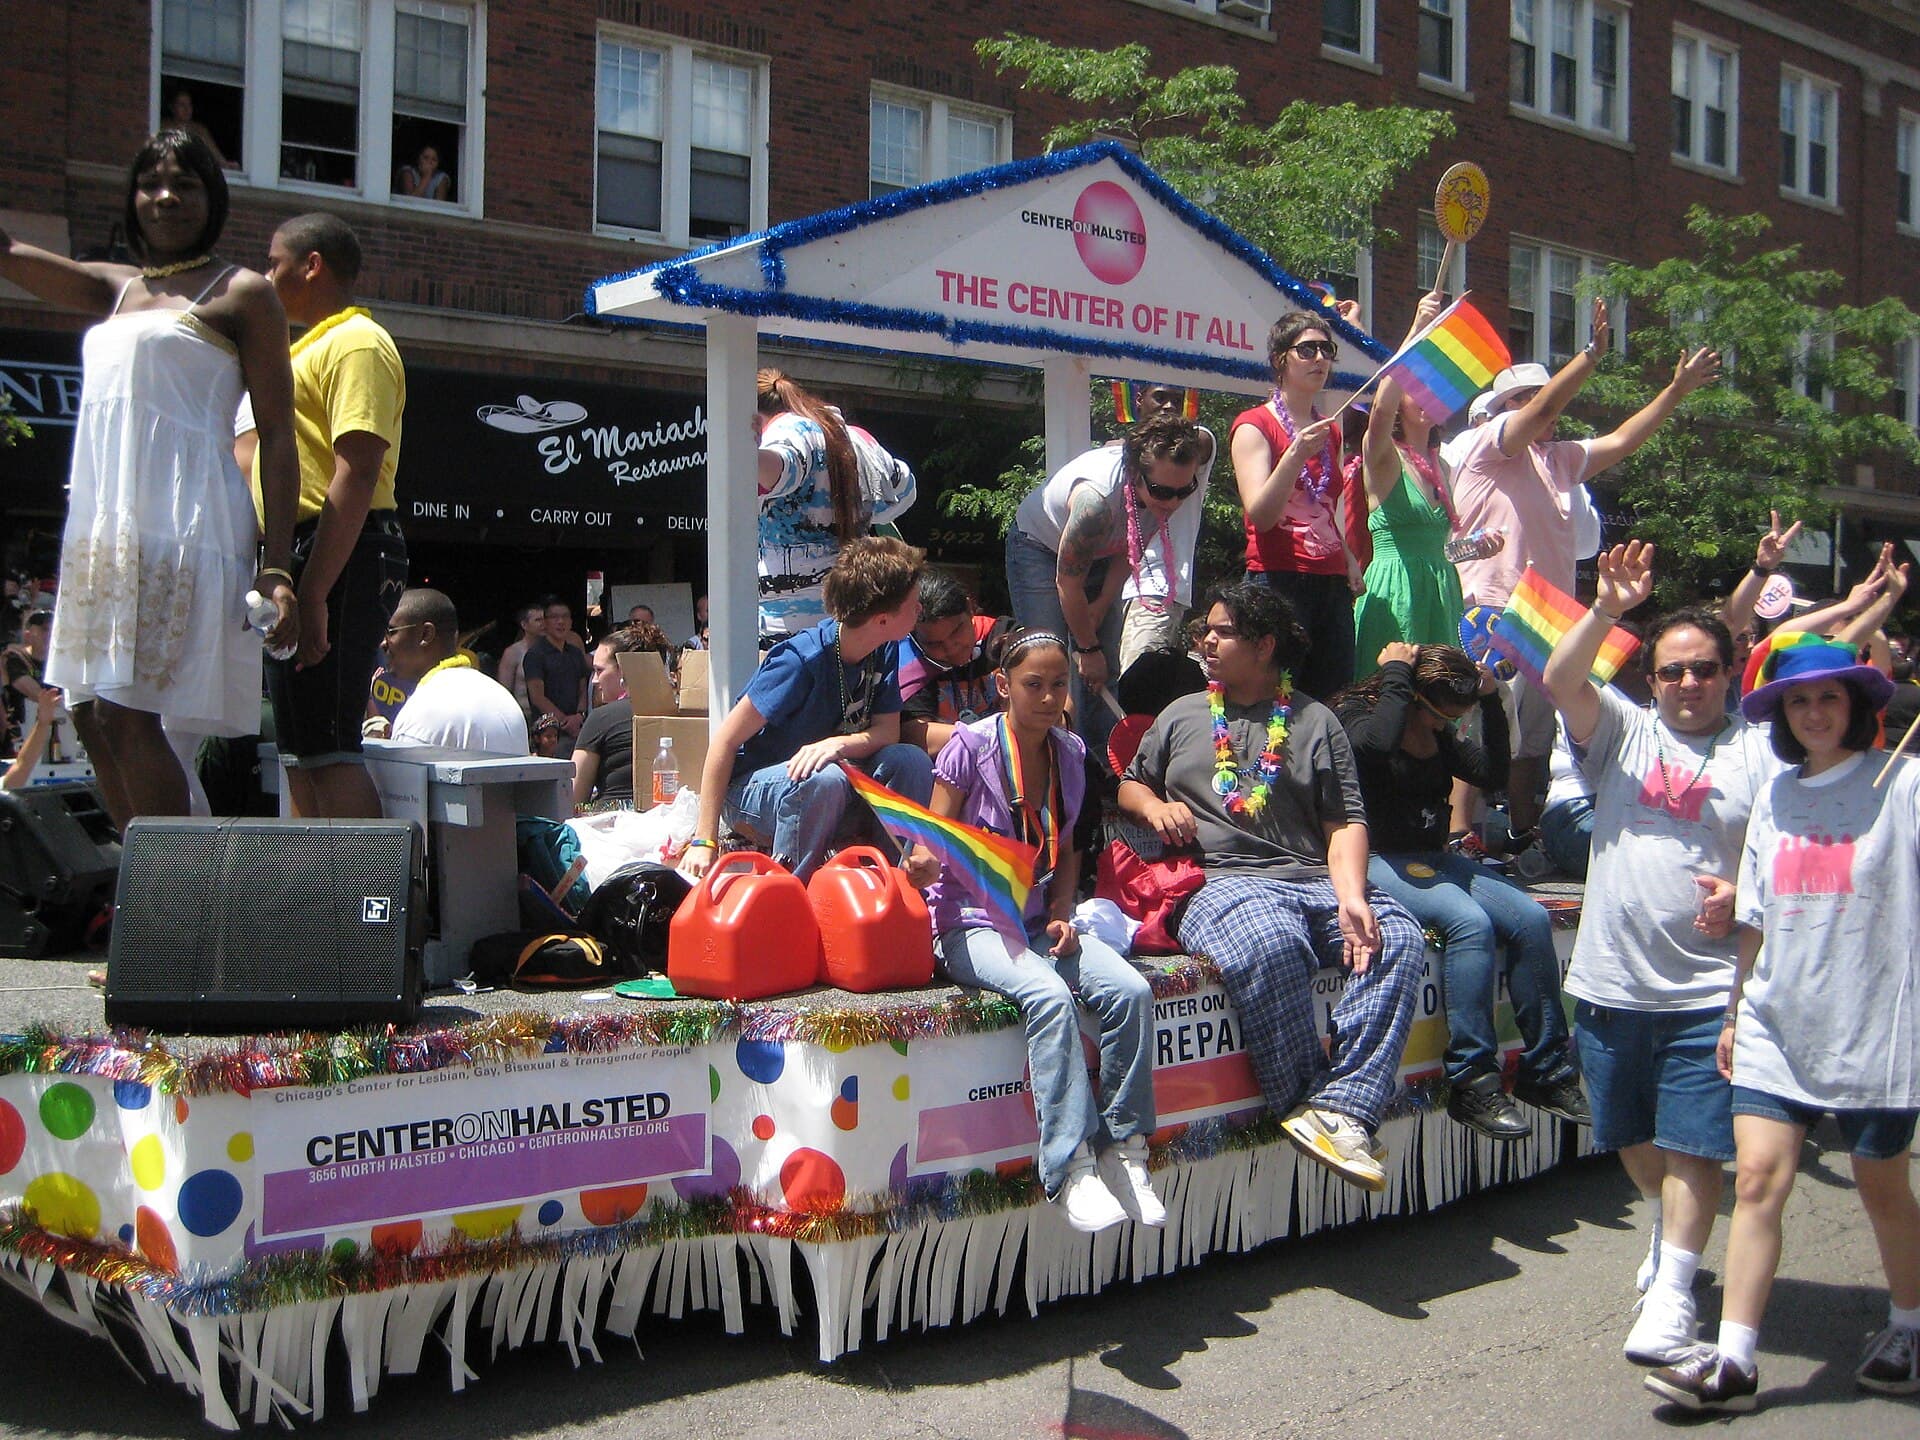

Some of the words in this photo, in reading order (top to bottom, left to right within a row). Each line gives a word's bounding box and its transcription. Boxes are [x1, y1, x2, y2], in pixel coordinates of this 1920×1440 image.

[935, 269, 998, 310] THE
[1007, 282, 1125, 330] CENTER
[1132, 302, 1168, 336] OF
[1175, 310, 1200, 341] IT
[1205, 316, 1254, 351] ALL
[537, 435, 582, 474] El
[413, 501, 447, 519] DINE
[454, 504, 470, 520] IN
[530, 508, 579, 525] CARRY
[584, 510, 613, 527] OUT
[1152, 997, 1197, 1021] NTER
[1201, 994, 1225, 1013] ON
[275, 1085, 343, 1104] Chicago's
[347, 1081, 391, 1095] Center
[396, 1077, 414, 1088] for
[419, 1069, 470, 1086] Lesbian,
[474, 1066, 500, 1078] Gay,
[505, 1058, 556, 1073] Bisexual
[560, 1057, 570, 1068] &
[575, 1051, 648, 1067] Transgender
[651, 1046, 692, 1059] People
[309, 1169, 337, 1184] 3656
[341, 1160, 386, 1179] NORTH
[390, 1151, 446, 1171] HALSTED
[459, 1140, 515, 1160] CHICAGO
[529, 1121, 670, 1150] CENTERONHALSTED.ORG
